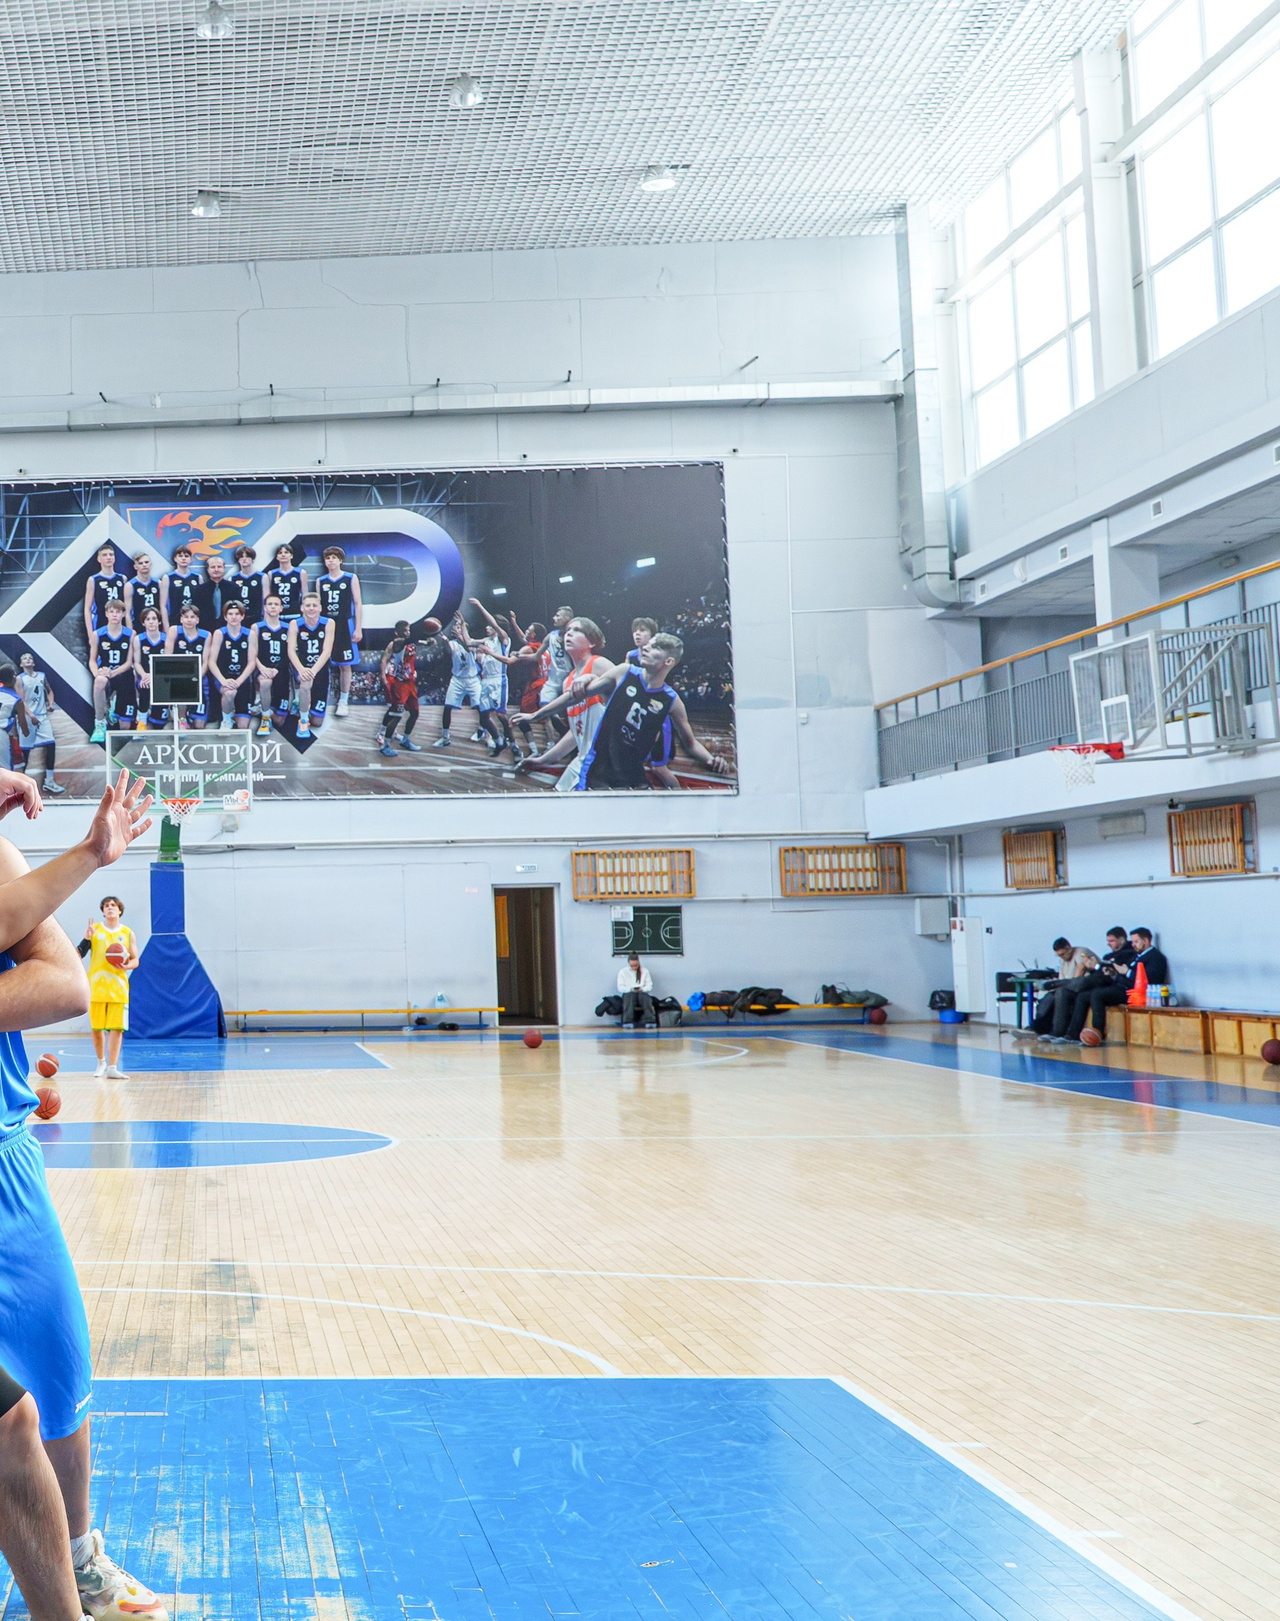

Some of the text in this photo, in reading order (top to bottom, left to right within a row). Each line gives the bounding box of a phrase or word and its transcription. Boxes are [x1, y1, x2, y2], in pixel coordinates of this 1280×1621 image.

[106, 586, 119, 600] 34
[183, 585, 191, 598] 4
[241, 586, 249, 599] 8
[327, 590, 340, 603] 15
[269, 640, 281, 655] 19
[307, 639, 319, 654] 12
[109, 650, 121, 664] 13
[231, 649, 239, 663] 5
[343, 650, 353, 661] 15
[125, 704, 135, 716] 13
[315, 700, 326, 712] 12
[134, 739, 283, 765] АРХСТРОЙ
[162, 774, 202, 783] ГРППА
